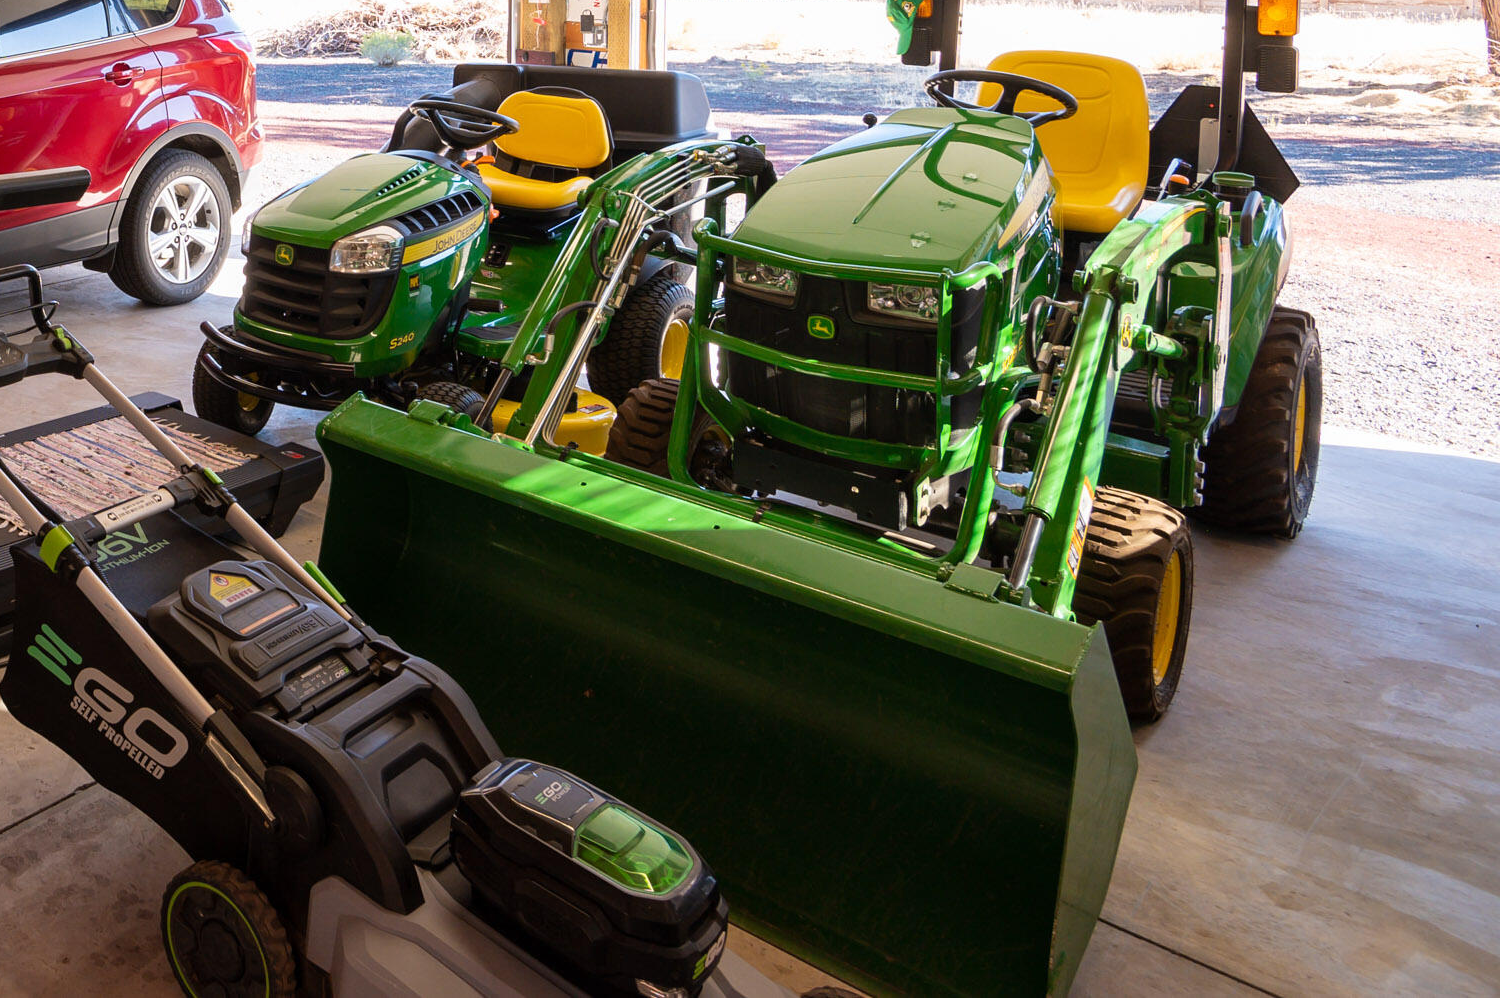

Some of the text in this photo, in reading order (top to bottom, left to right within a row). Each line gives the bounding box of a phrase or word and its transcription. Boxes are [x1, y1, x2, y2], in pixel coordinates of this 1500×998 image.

[433, 220, 478, 253] JOHN DEERE
[389, 332, 415, 350] S240
[27, 623, 189, 768] EGO
[69, 694, 166, 781] SELF PROPELLED
[534, 781, 563, 806] EGO
